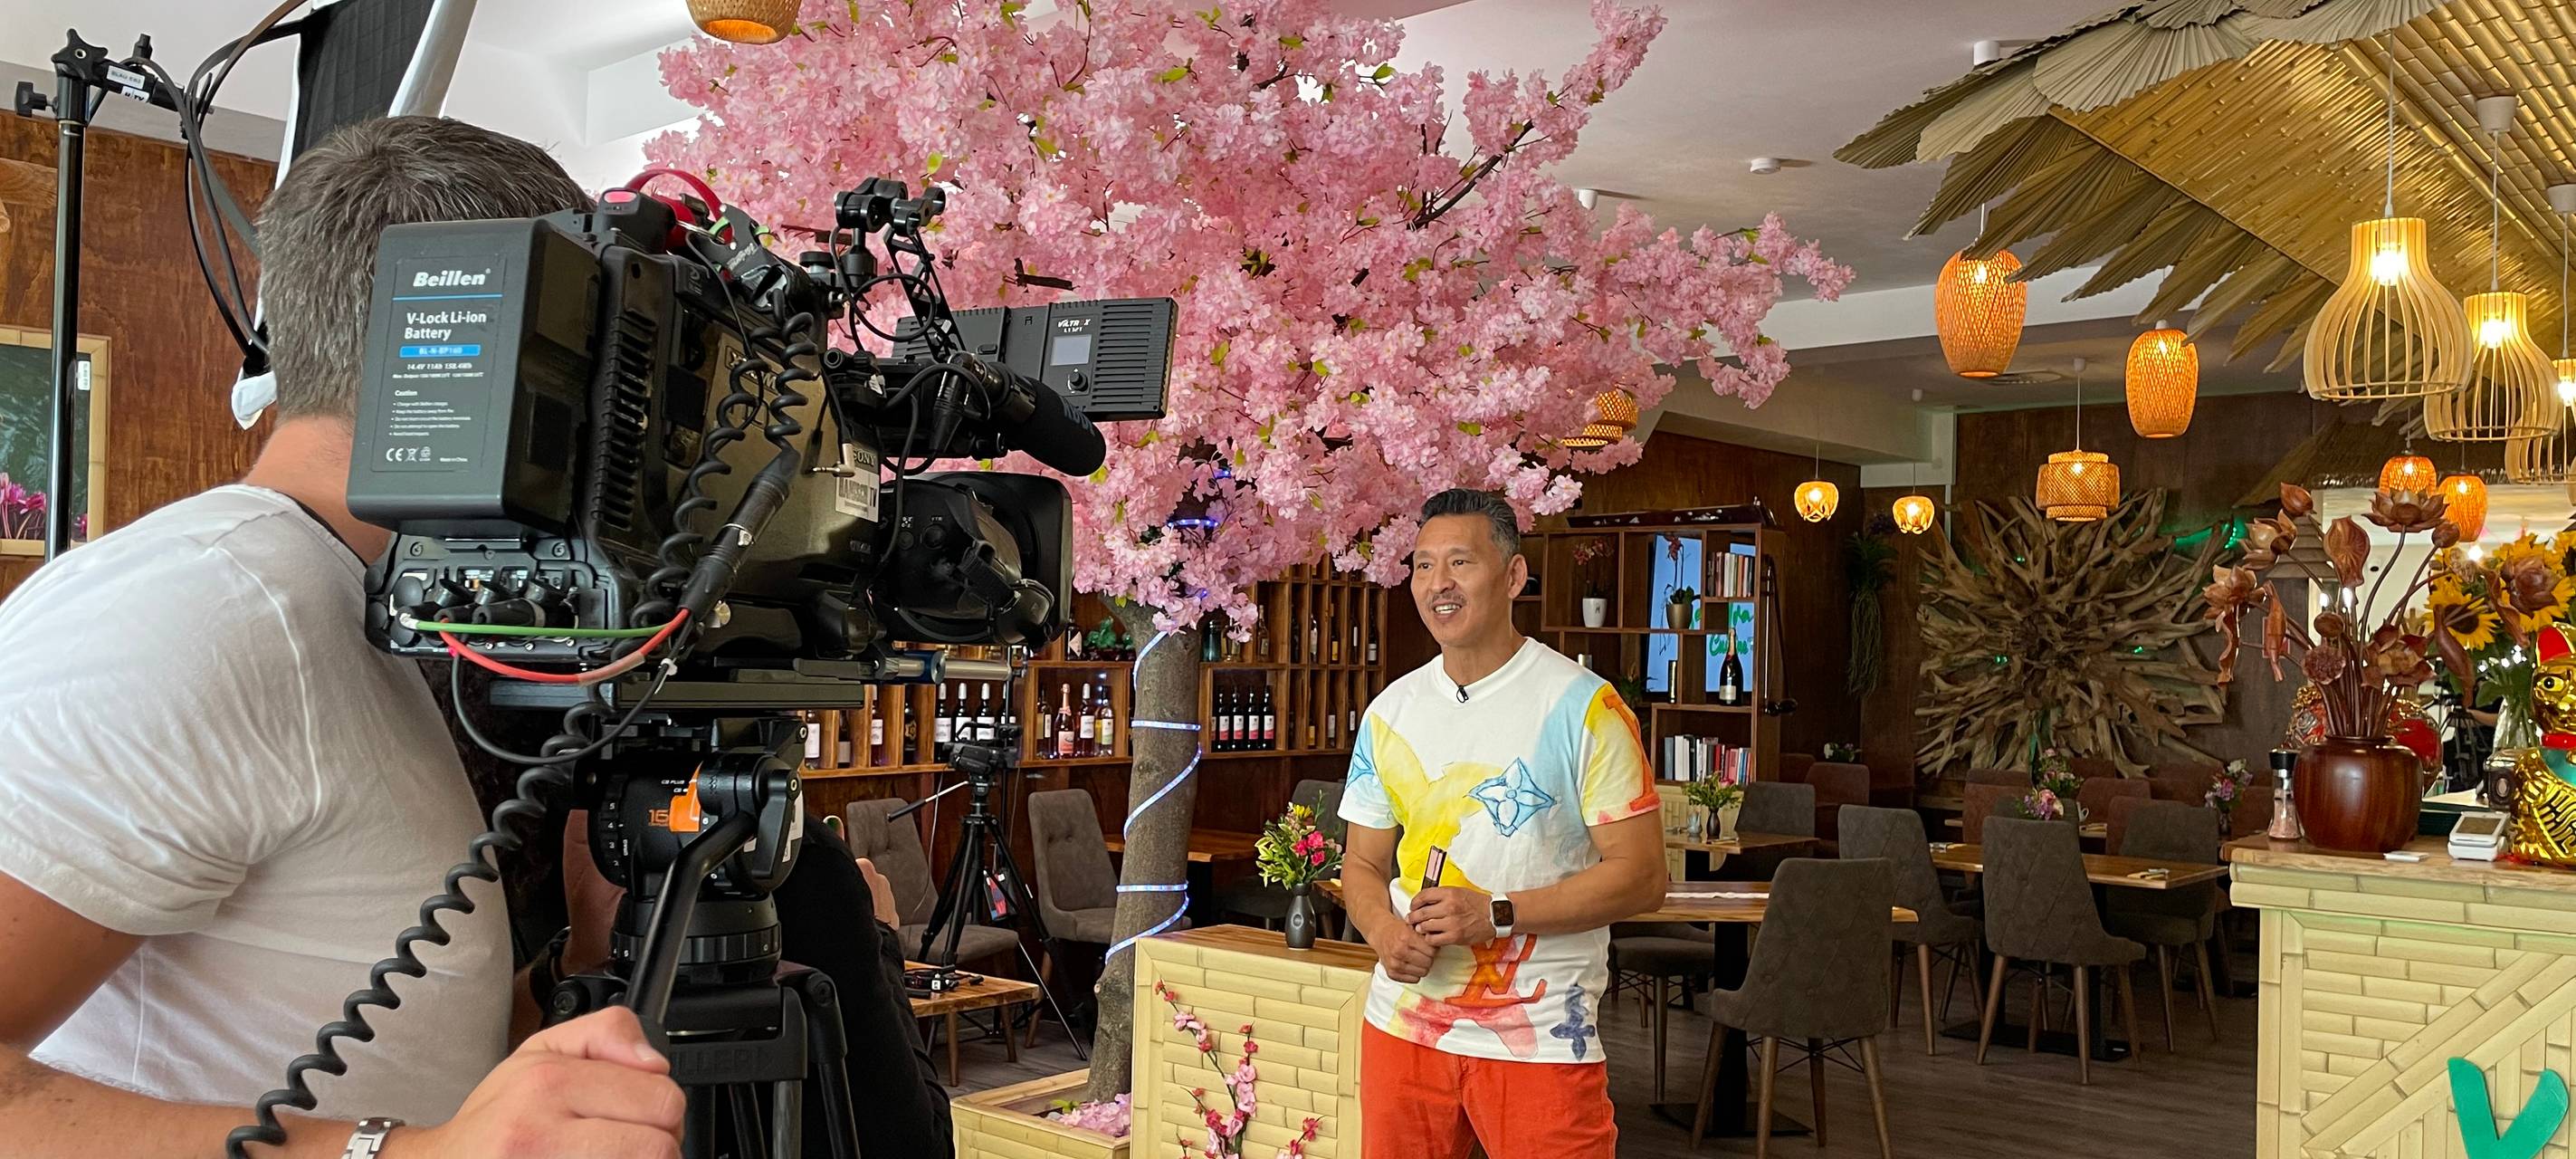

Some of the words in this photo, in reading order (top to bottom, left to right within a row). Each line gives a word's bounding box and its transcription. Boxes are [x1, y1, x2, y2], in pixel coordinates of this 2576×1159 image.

[413, 270, 486, 287] Beillen
[406, 311, 449, 325] V-Lock
[450, 311, 487, 323] Li-ion
[404, 327, 452, 341] Battery
